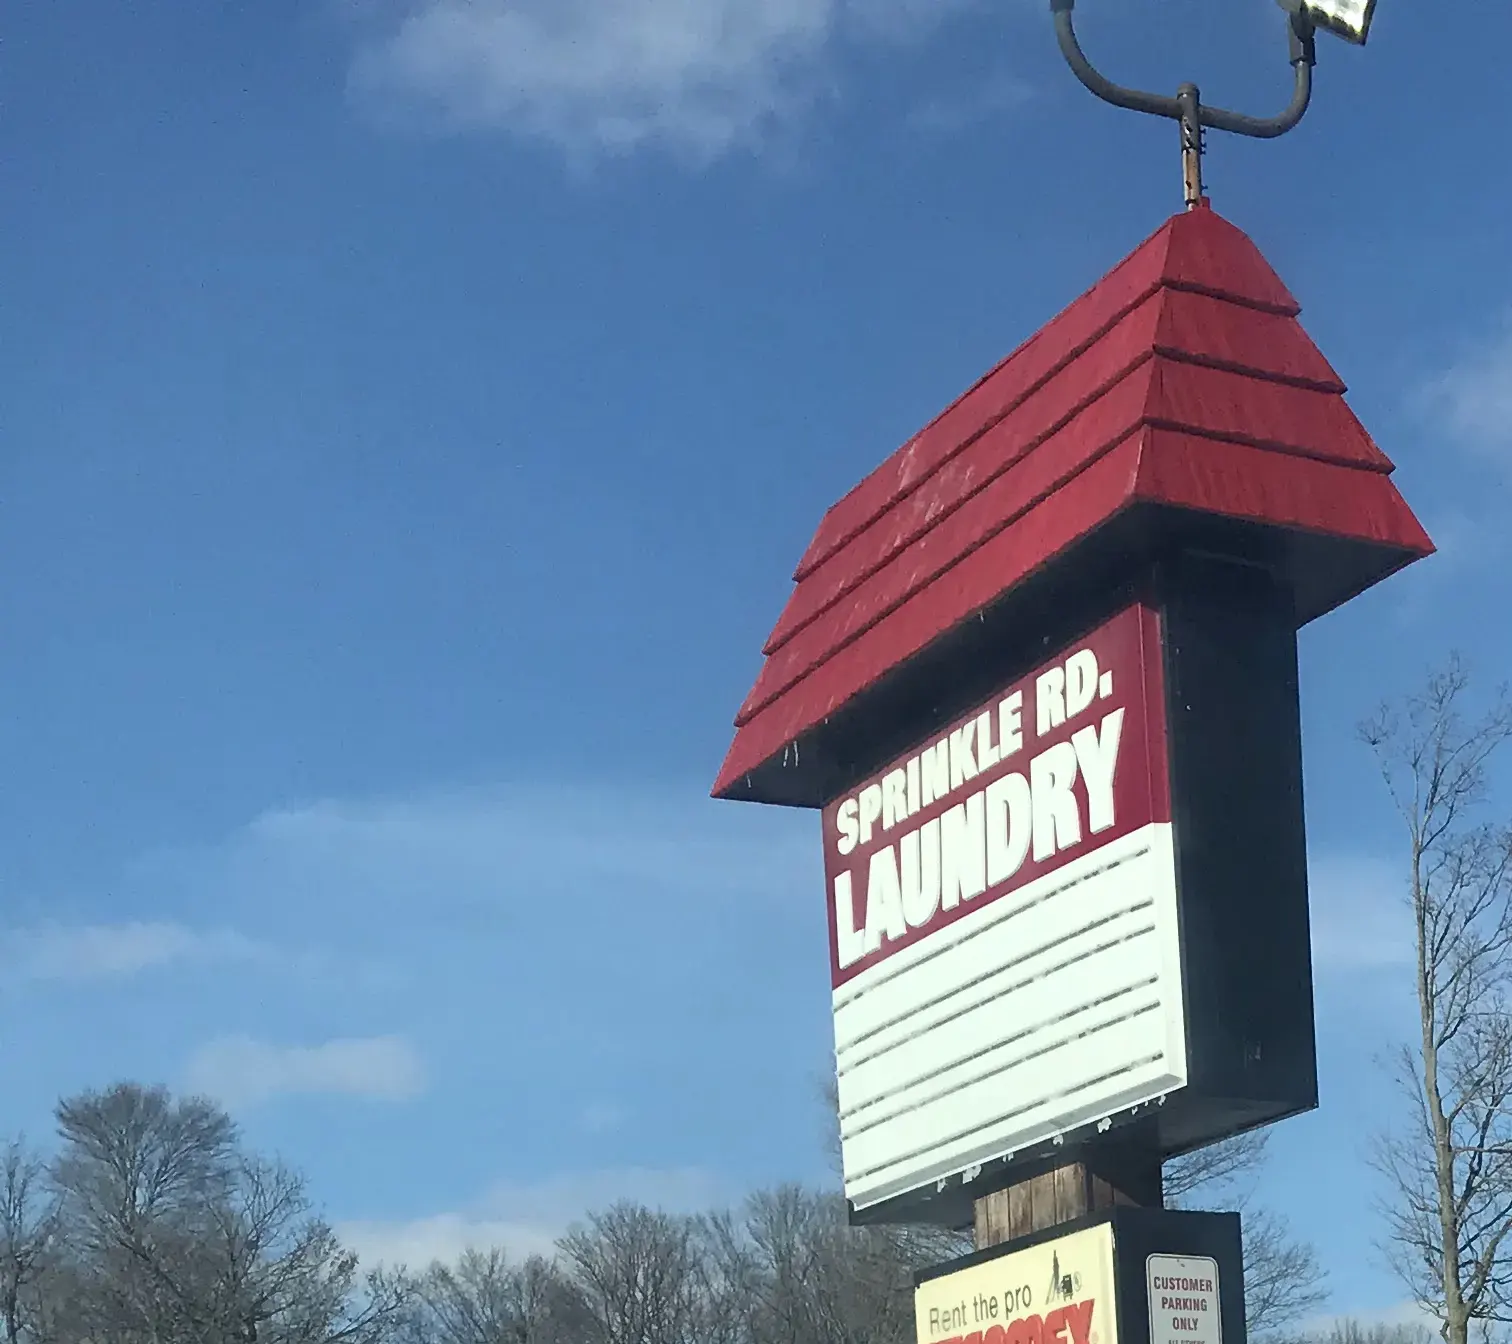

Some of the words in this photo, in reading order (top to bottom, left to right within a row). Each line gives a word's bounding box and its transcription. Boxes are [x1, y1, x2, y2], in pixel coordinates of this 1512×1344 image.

[835, 689, 1023, 856] SPRINKLE
[1035, 648, 1113, 737] RD.
[833, 708, 1125, 970] LAUNDRY
[1153, 1276, 1213, 1293] CUSTOMER
[929, 1304, 967, 1335] Rent
[973, 1293, 998, 1323] the
[1005, 1284, 1032, 1319] pro
[1161, 1296, 1208, 1312] PARKING
[1172, 1317, 1199, 1332] ONLY
